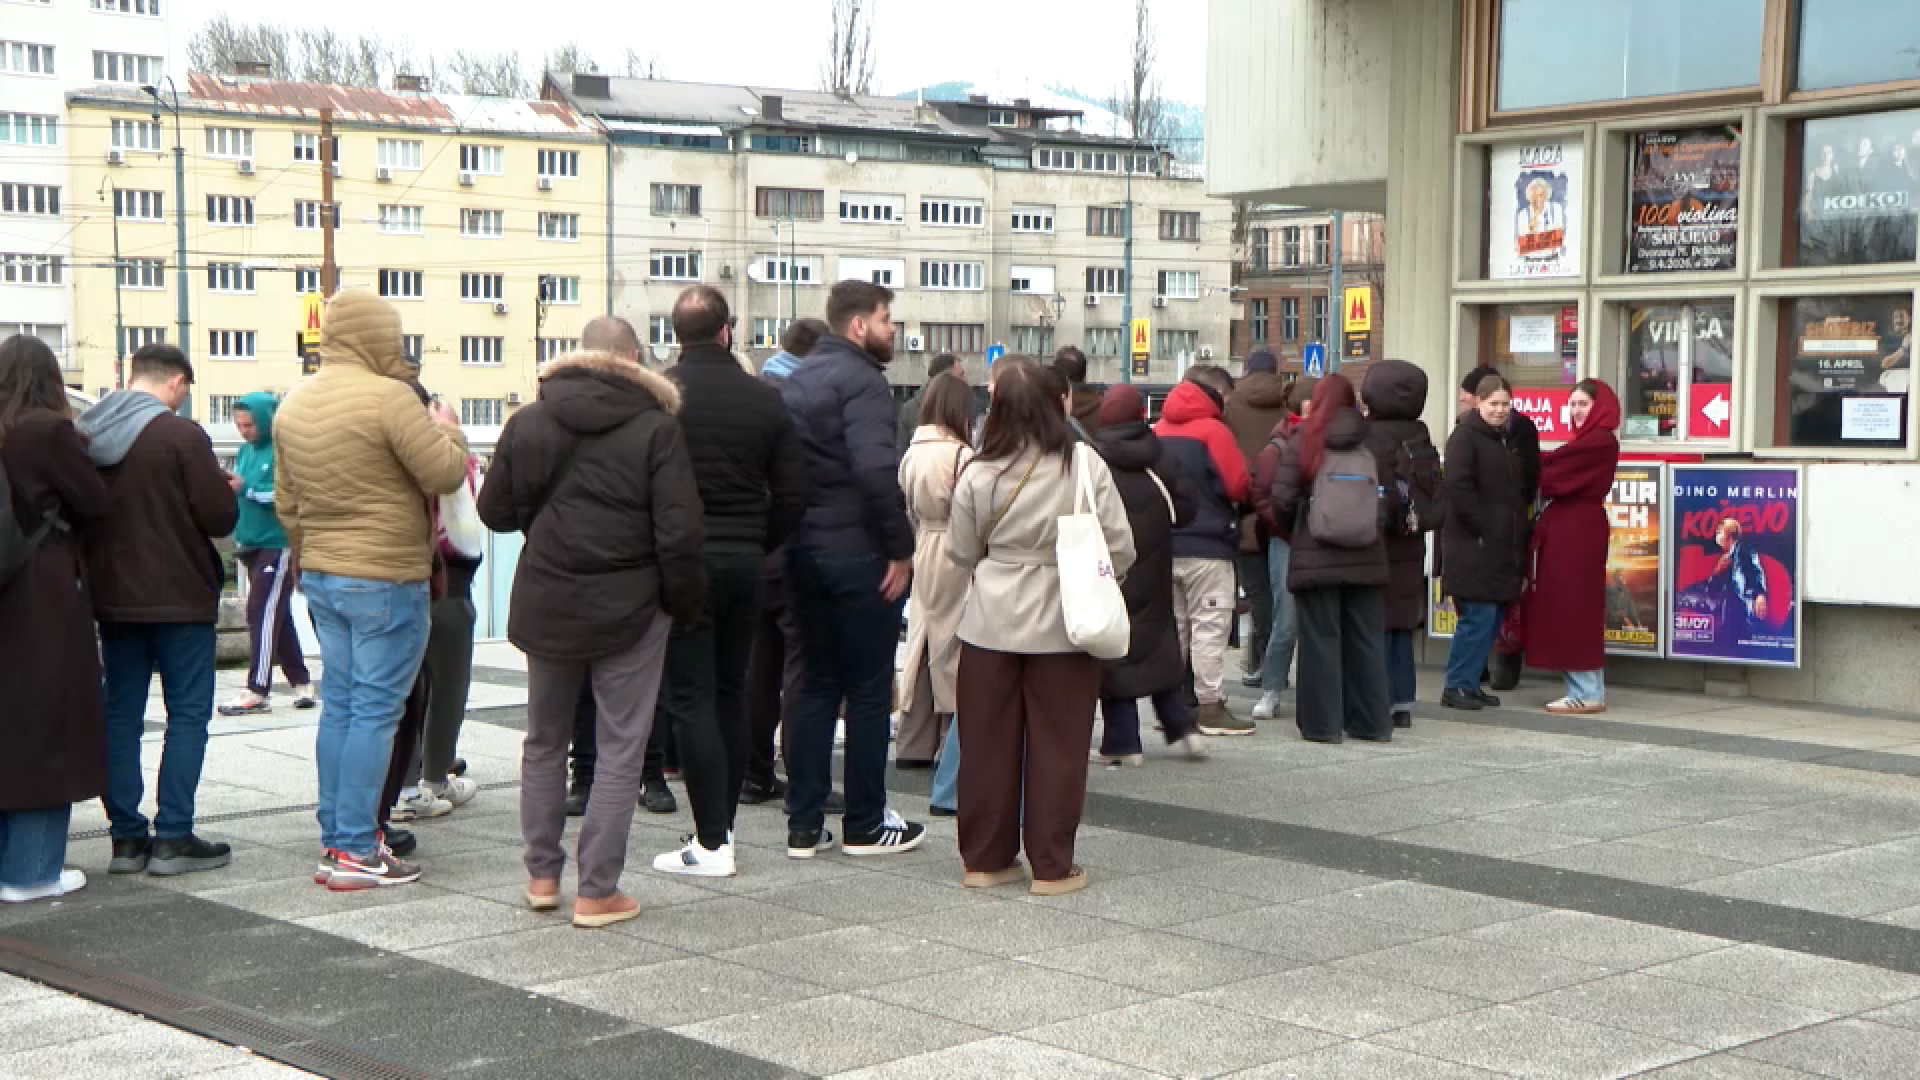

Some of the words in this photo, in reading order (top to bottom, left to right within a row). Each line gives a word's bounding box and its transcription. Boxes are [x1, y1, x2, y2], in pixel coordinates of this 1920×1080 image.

[1640, 203, 1670, 224] 100
[1678, 202, 1737, 223] violina
[1651, 230, 1720, 246] SARAJEVO
[1510, 397, 1552, 413] DAJA
[1674, 485, 1717, 497] DINO
[1727, 485, 1797, 499] MERLIN
